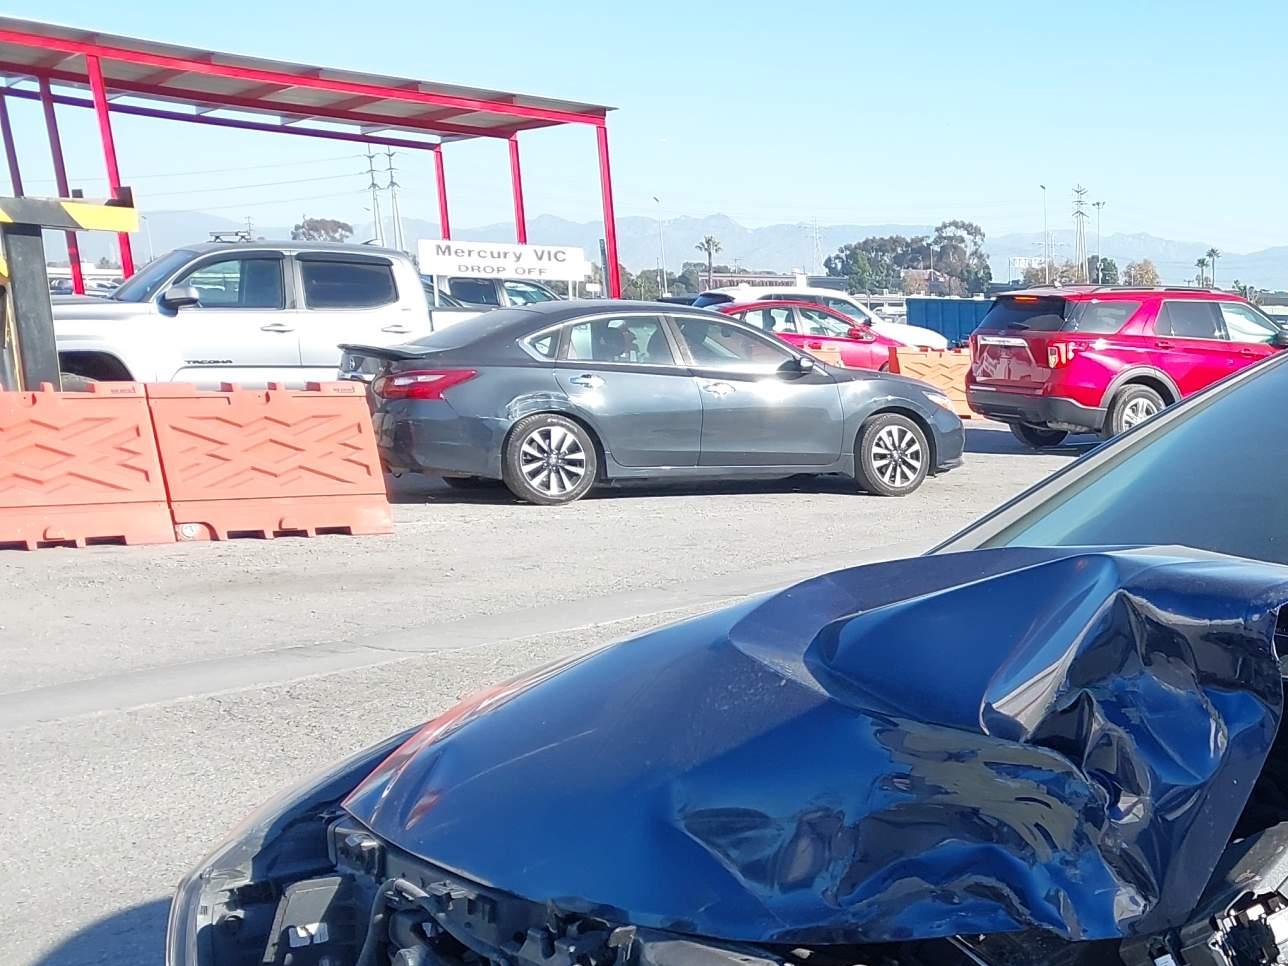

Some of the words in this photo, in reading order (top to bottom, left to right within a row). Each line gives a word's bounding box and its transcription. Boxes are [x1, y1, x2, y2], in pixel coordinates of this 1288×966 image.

[435, 244, 523, 263] Mercury
[533, 249, 568, 263] VIC
[457, 264, 506, 275] DROP
[514, 266, 548, 277] OFF
